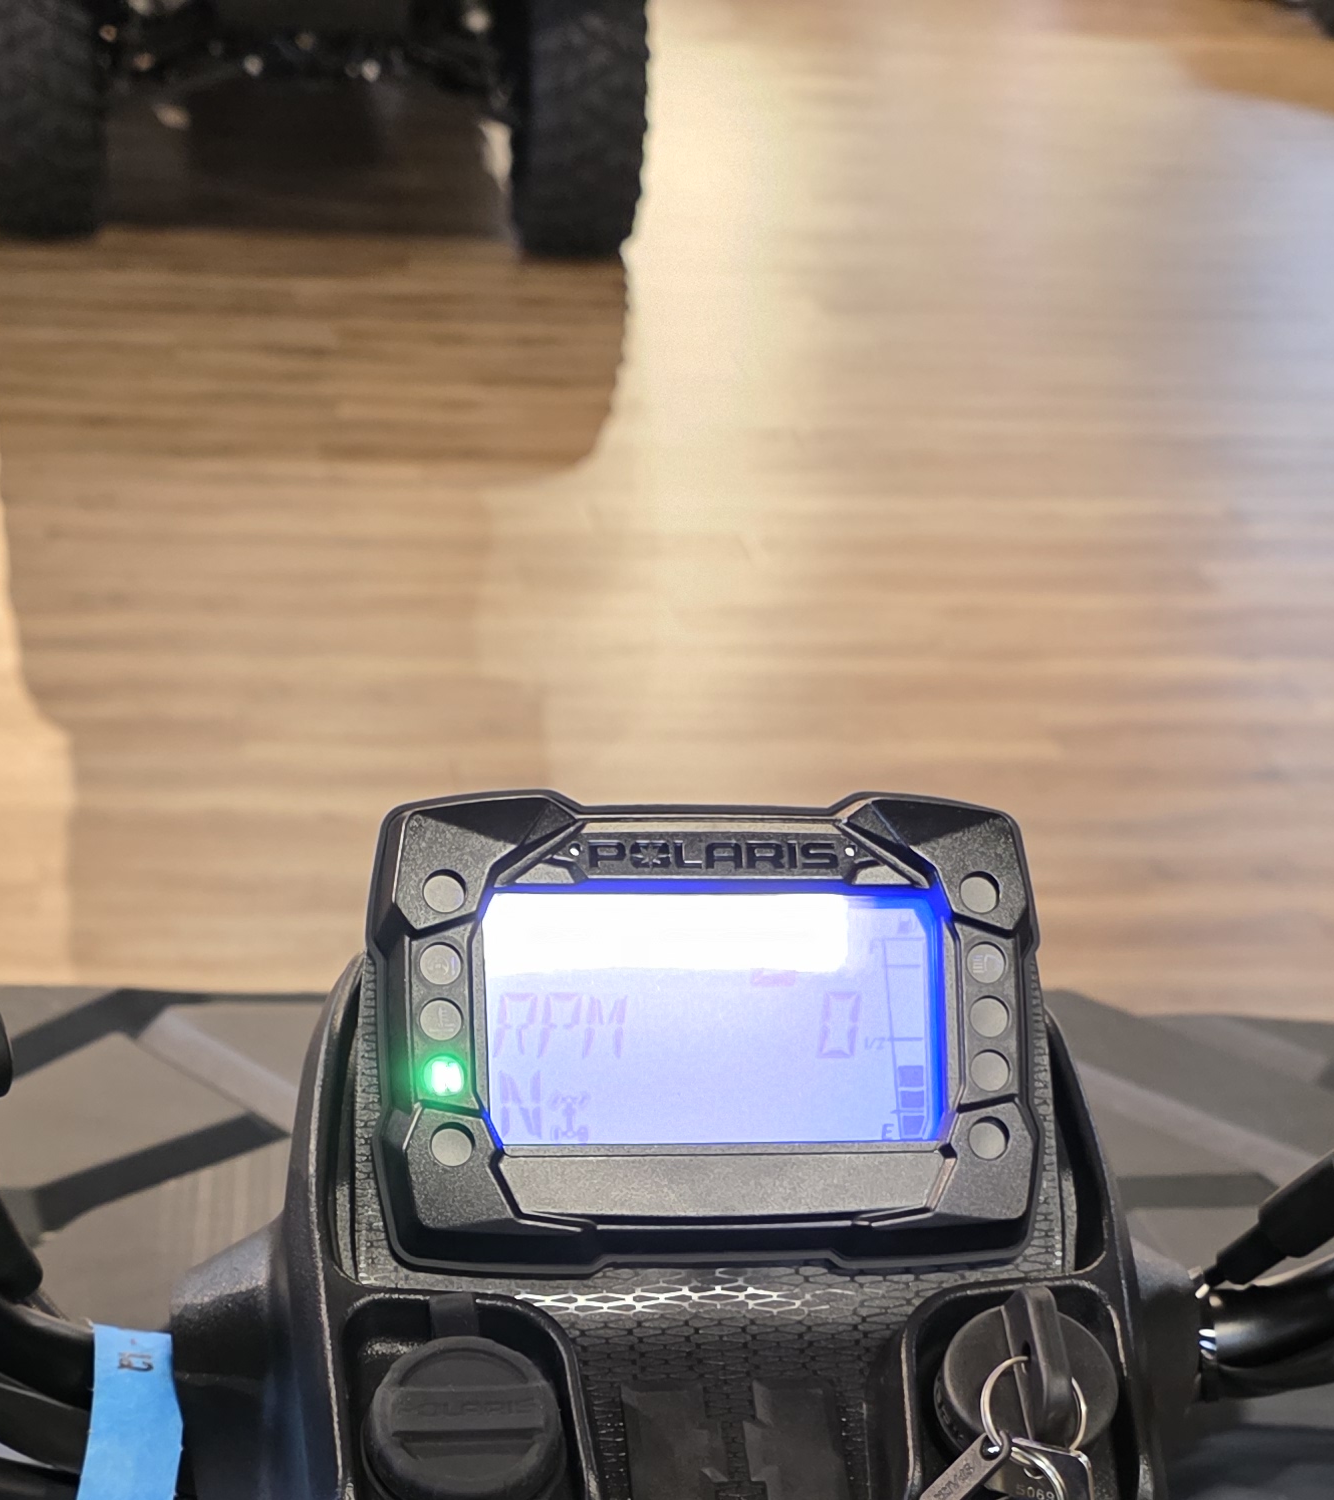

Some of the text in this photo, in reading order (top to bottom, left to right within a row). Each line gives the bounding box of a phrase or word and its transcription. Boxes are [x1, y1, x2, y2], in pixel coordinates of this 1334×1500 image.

[589, 842, 837, 869] POLARIS
[493, 990, 861, 1060] RPM 0
